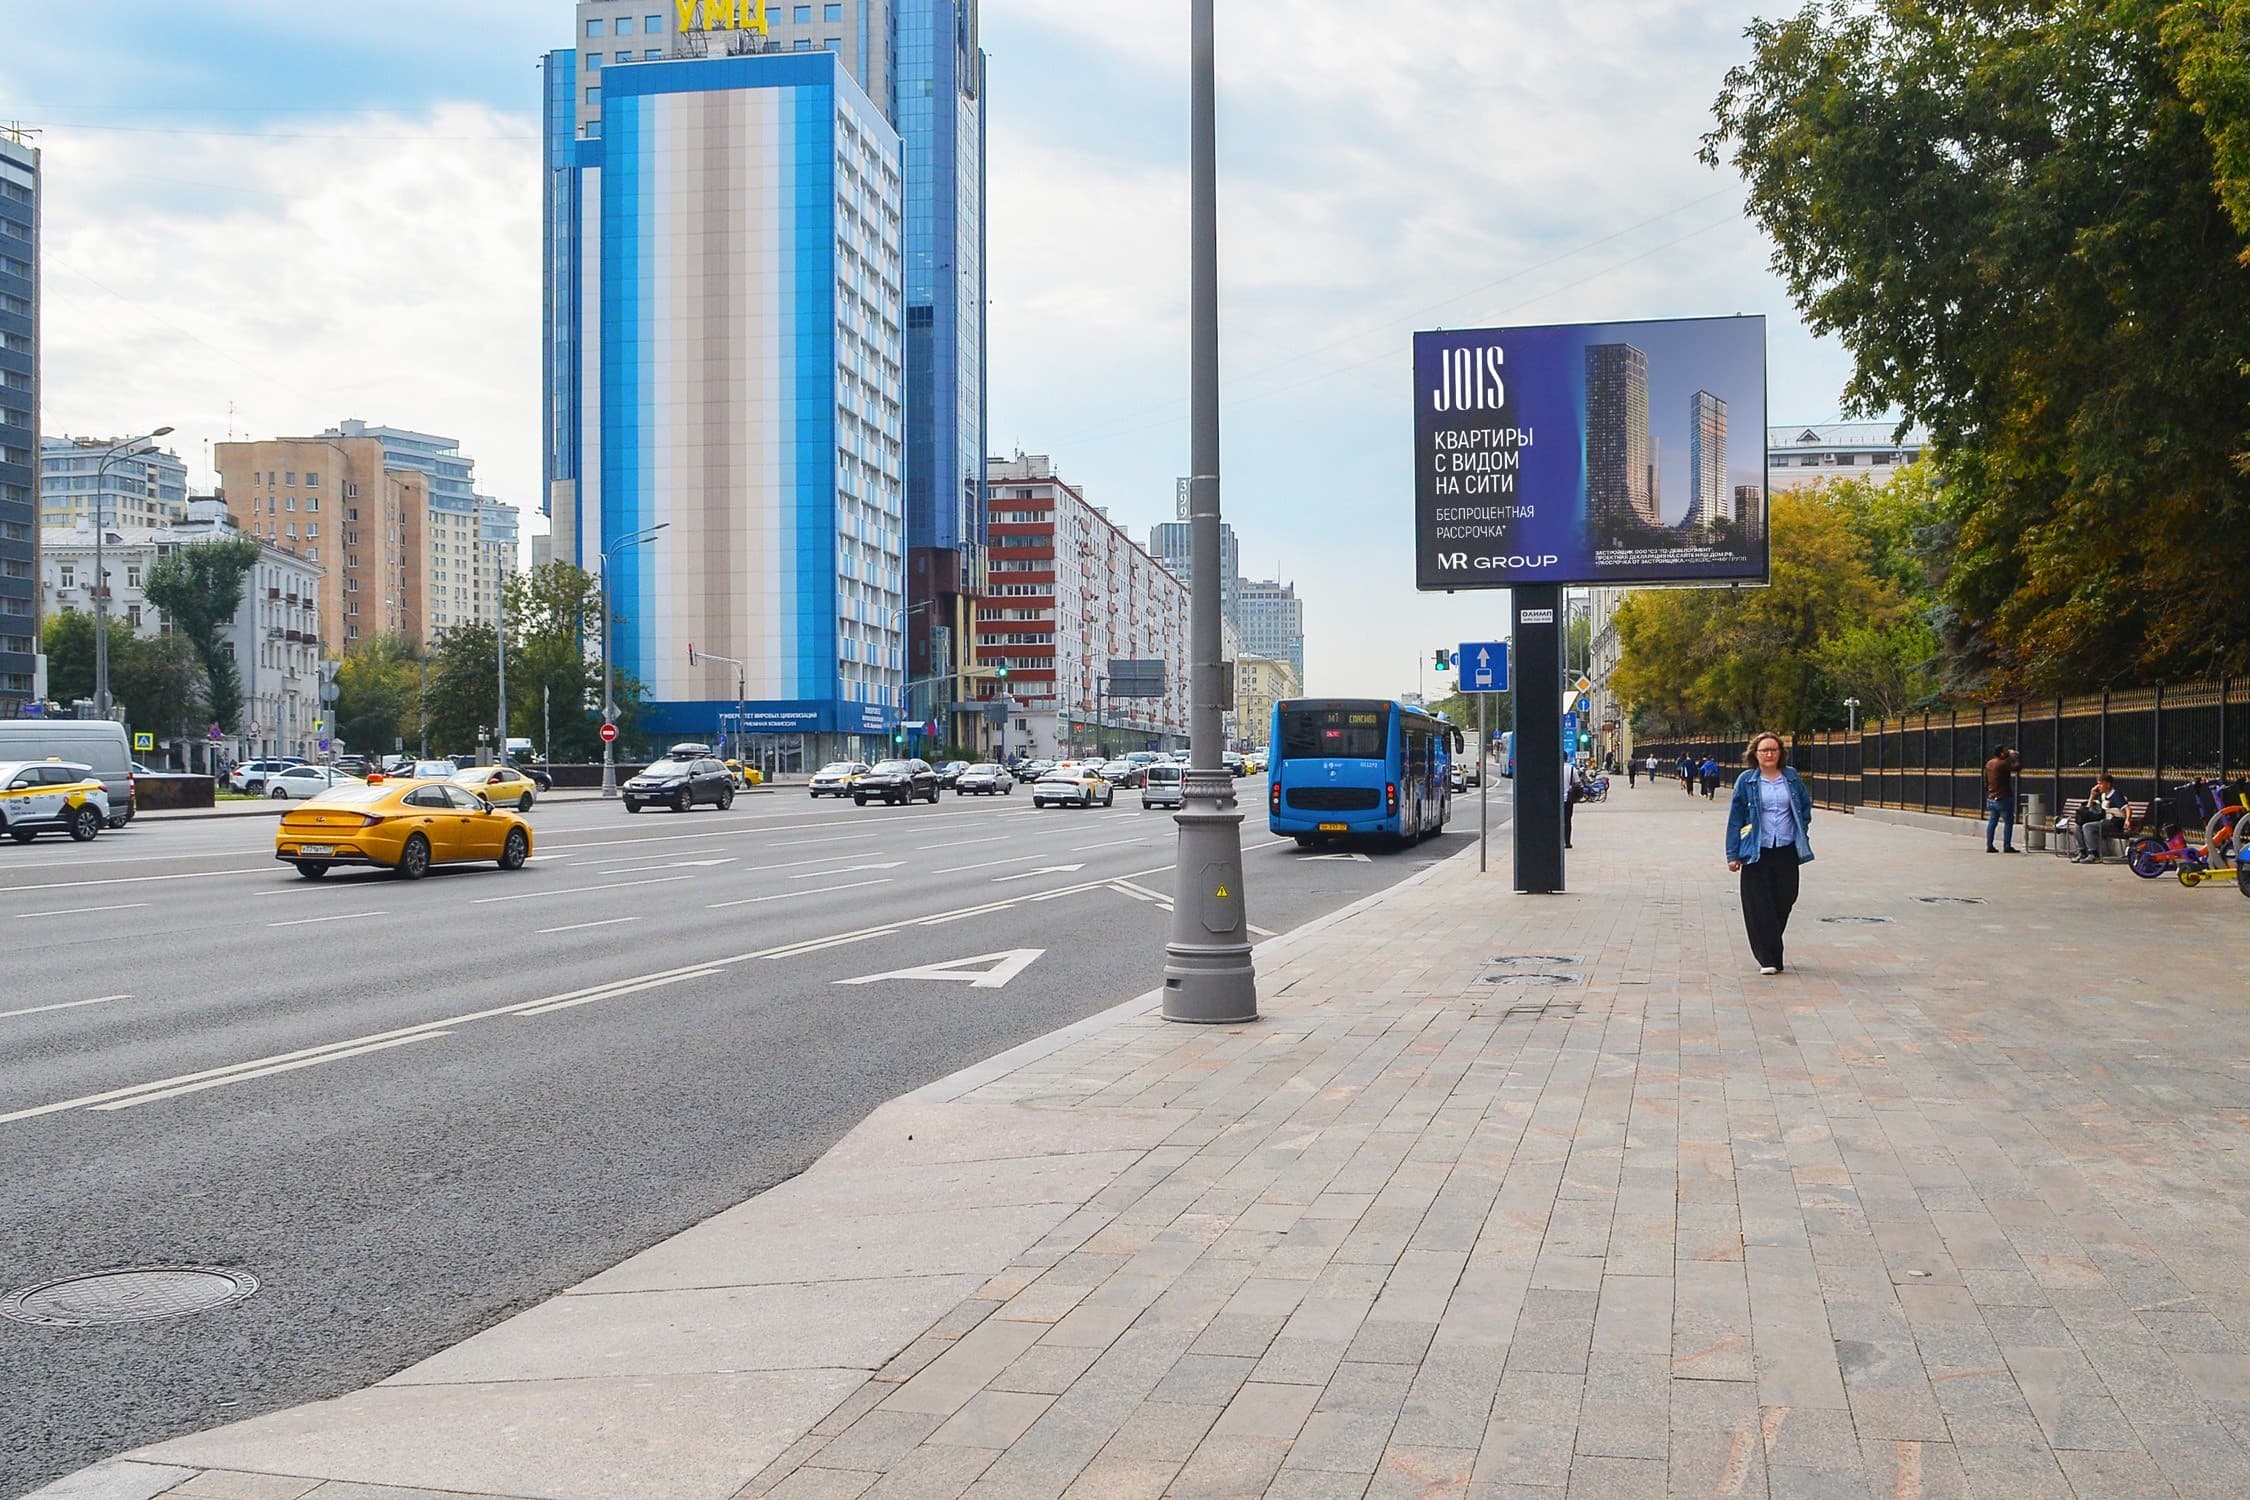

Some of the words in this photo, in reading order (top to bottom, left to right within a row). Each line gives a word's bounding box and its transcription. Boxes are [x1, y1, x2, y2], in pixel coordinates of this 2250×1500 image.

[673, 0, 768, 36] УМЦ
[1433, 346, 1505, 412] JOIS
[1435, 427, 1534, 450] КВАРТИРЫ
[1435, 453, 1447, 472] С
[1452, 450, 1519, 473] ВИДОМ
[1436, 476, 1460, 495] НА
[1465, 474, 1513, 494] СИТИ
[1436, 505, 1535, 521] БЕСПРОЦЕНТНАЯ
[1438, 552, 1468, 570] MR
[1474, 555, 1558, 569] GROUP
